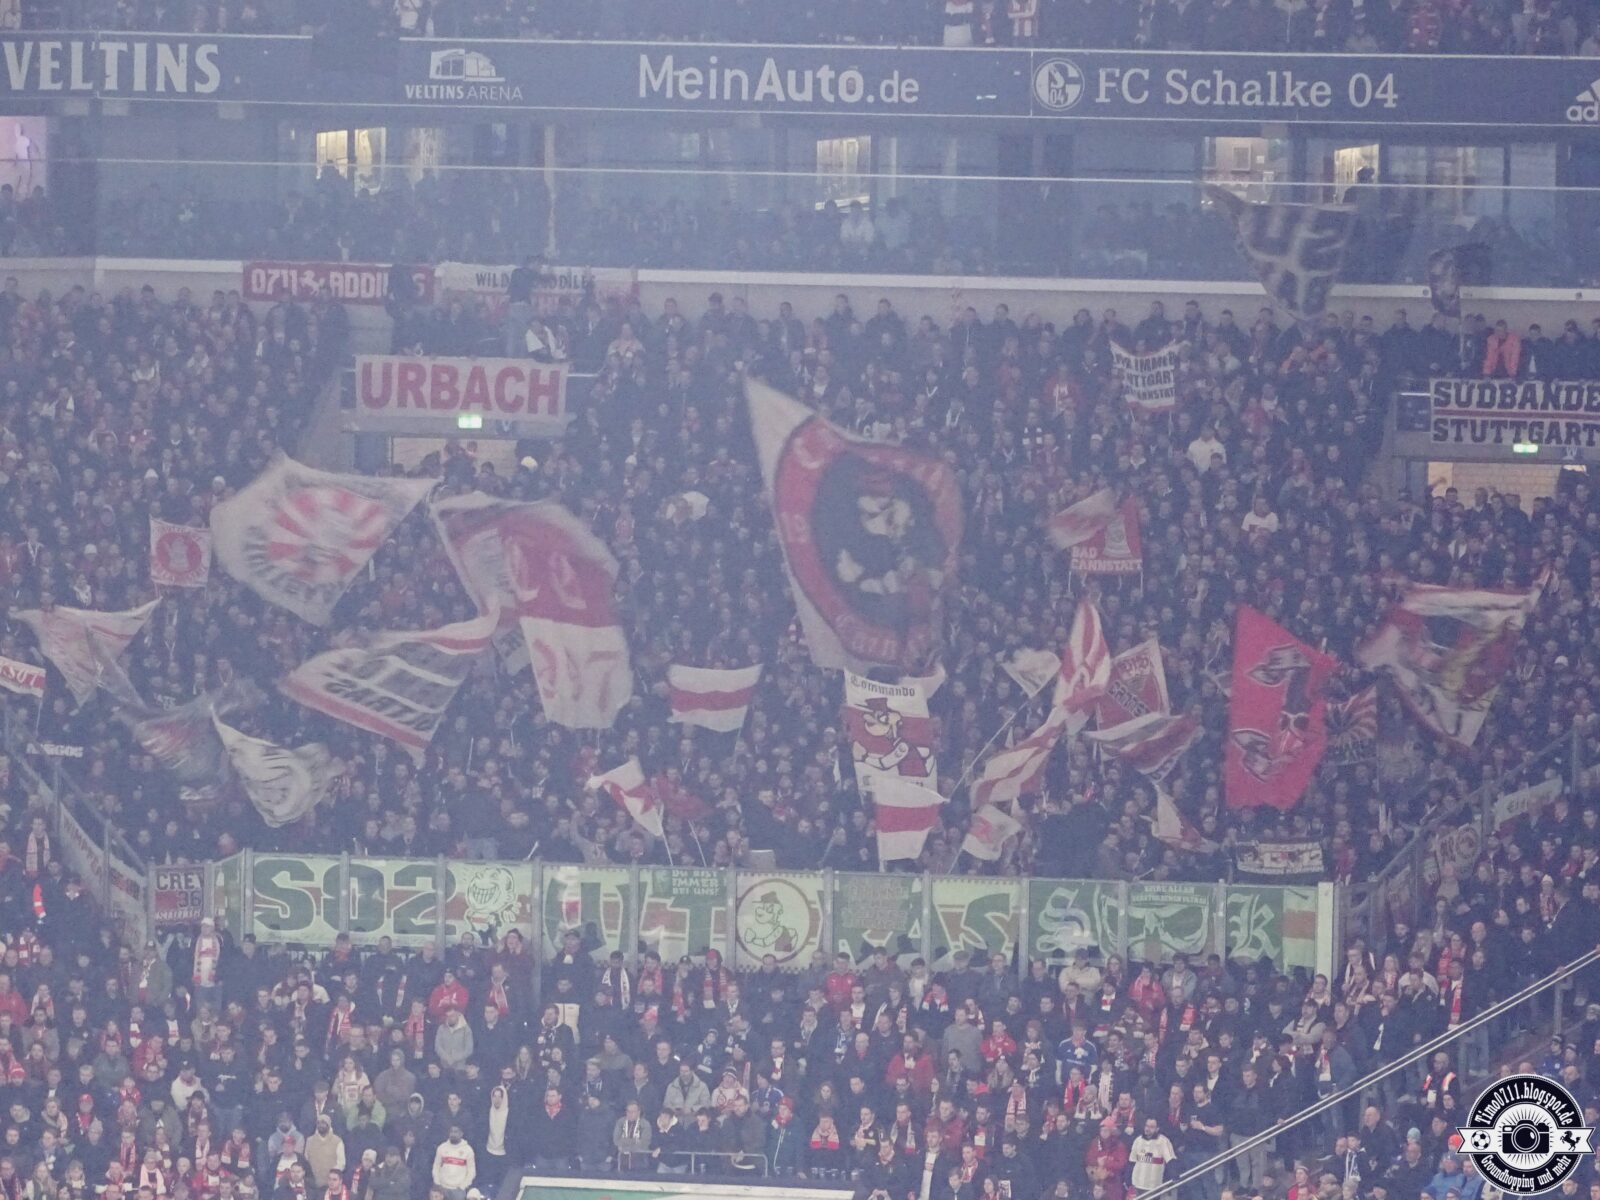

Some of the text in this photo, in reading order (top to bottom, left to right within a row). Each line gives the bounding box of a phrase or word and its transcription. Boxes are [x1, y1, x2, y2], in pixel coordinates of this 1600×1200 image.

[3, 41, 221, 93] VELTINS
[638, 54, 920, 103] MeinAuto.de
[405, 84, 523, 100] VELTINS ARENA
[1095, 68, 1398, 109] FC Schalke 04
[361, 361, 561, 416] URBACH
[1433, 418, 1600, 447] STUTTGART
[850, 674, 916, 697] Commando
